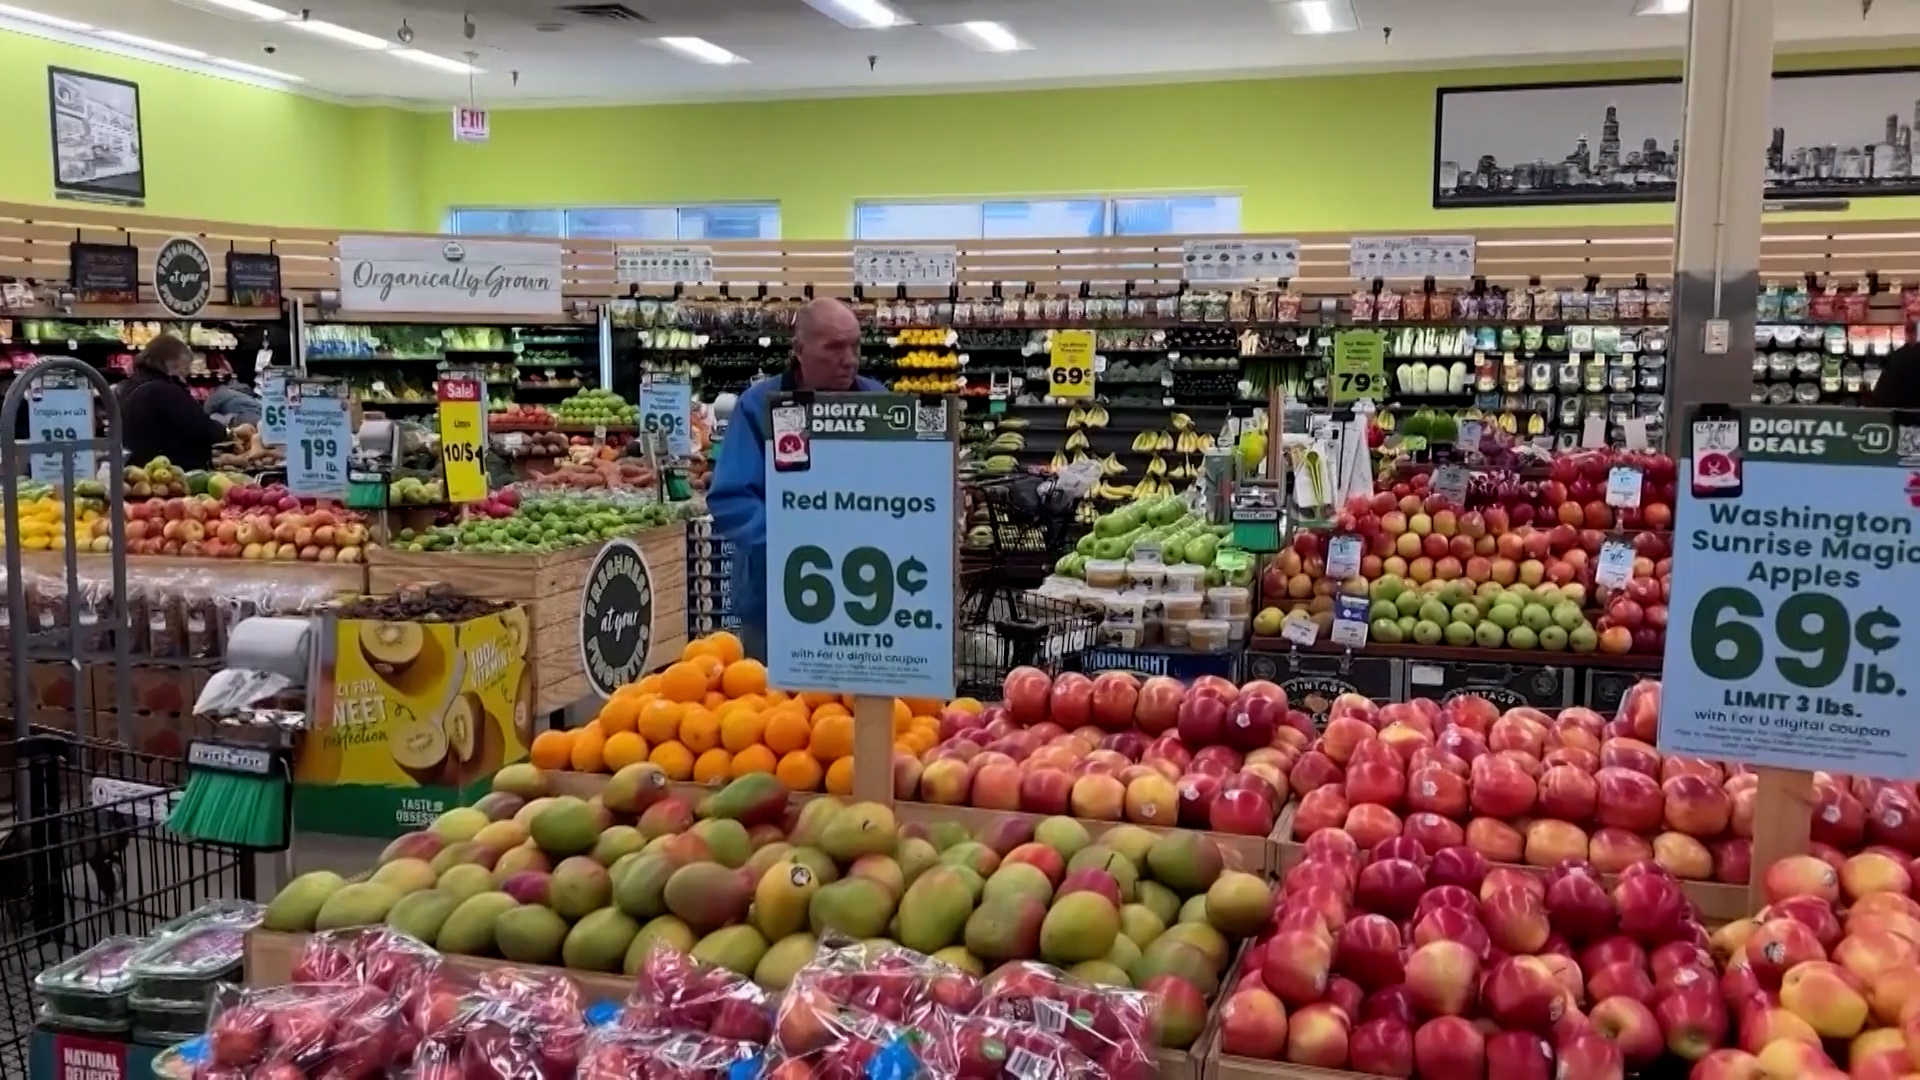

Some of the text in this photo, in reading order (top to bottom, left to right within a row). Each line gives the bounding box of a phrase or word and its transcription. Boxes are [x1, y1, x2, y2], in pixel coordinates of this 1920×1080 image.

[461, 109, 485, 131] EXIT
[353, 260, 551, 301] Organically Grown
[812, 403, 880, 418] DIGITAL
[812, 419, 866, 432] DEALS
[1749, 417, 1848, 437] DIGITAL
[1747, 437, 1827, 455] DEALS
[782, 490, 937, 519] Red Mangos
[1709, 503, 1912, 539] Washington
[1692, 529, 1920, 570] Sunrise Magic
[1747, 561, 1861, 592] Apples
[601, 606, 614, 631] at
[894, 609, 943, 630] ea.
[824, 632, 894, 648] LIMIT 10
[791, 649, 814, 659] with
[836, 651, 844, 660] U
[847, 651, 881, 664] digital
[884, 654, 929, 666] coupon
[1083, 651, 1171, 677] MOONLIGHT
[1852, 663, 1907, 697] lb.
[1724, 689, 1863, 718] LIMIT 3 lbs.
[1695, 709, 1727, 723] with
[1758, 715, 1770, 726] U
[1774, 716, 1824, 733] digital
[1829, 723, 1891, 738] coupon
[63, 1047, 120, 1072] NATURAL
